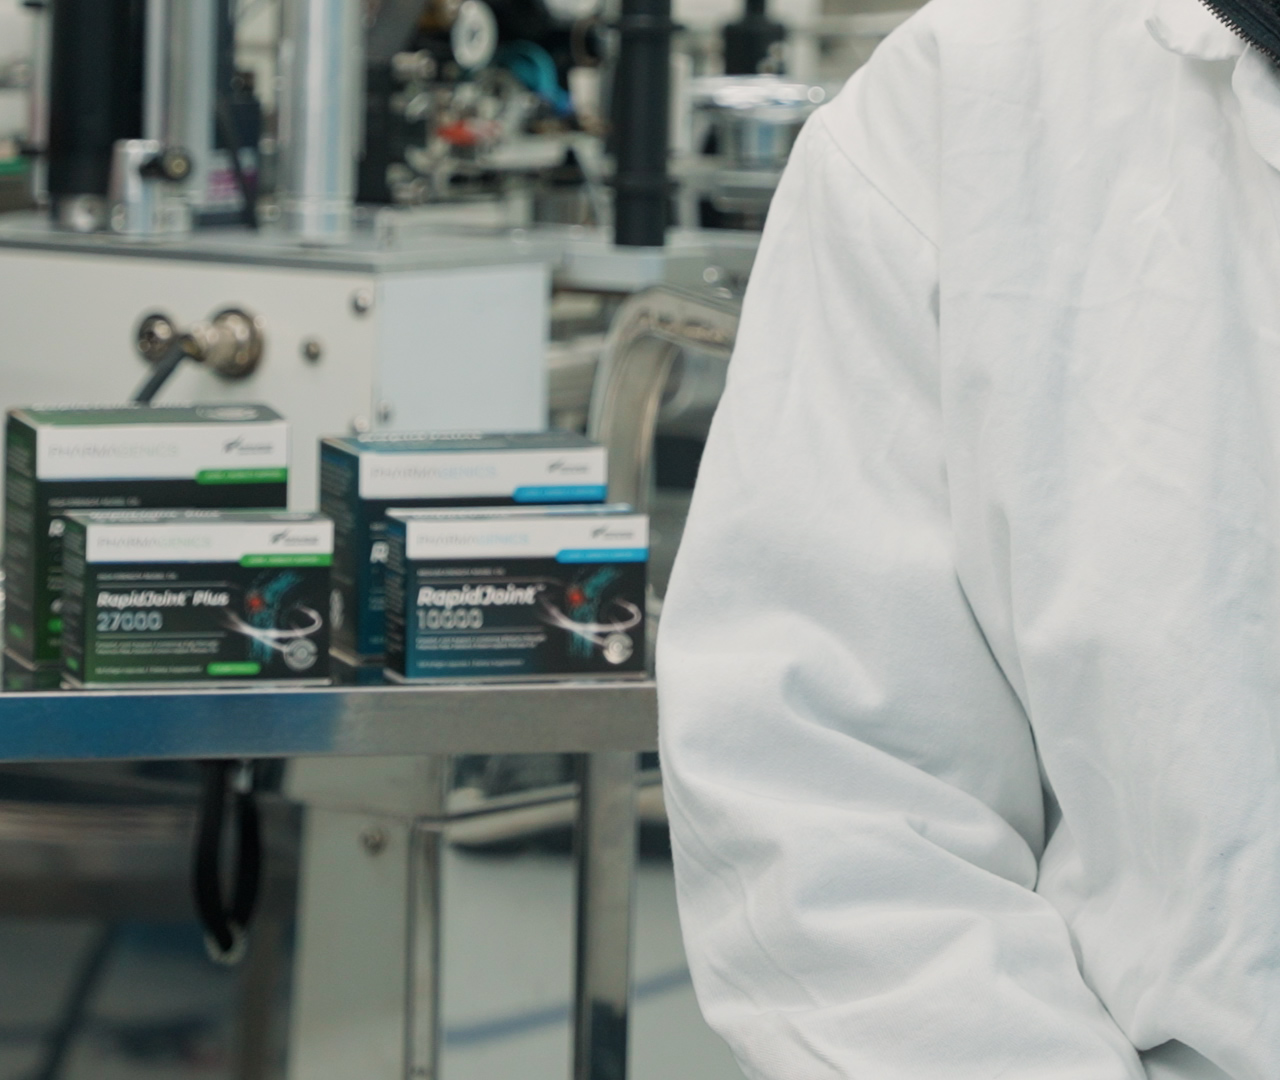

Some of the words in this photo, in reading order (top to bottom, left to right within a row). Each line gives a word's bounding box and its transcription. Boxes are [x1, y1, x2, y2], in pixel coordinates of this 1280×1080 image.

[48, 442, 178, 459] PHARMAGENICS
[369, 465, 497, 480] PHARMAGENICS
[192, 589, 230, 606] Plus
[96, 611, 164, 631] 27000
[416, 608, 484, 629] 10000
